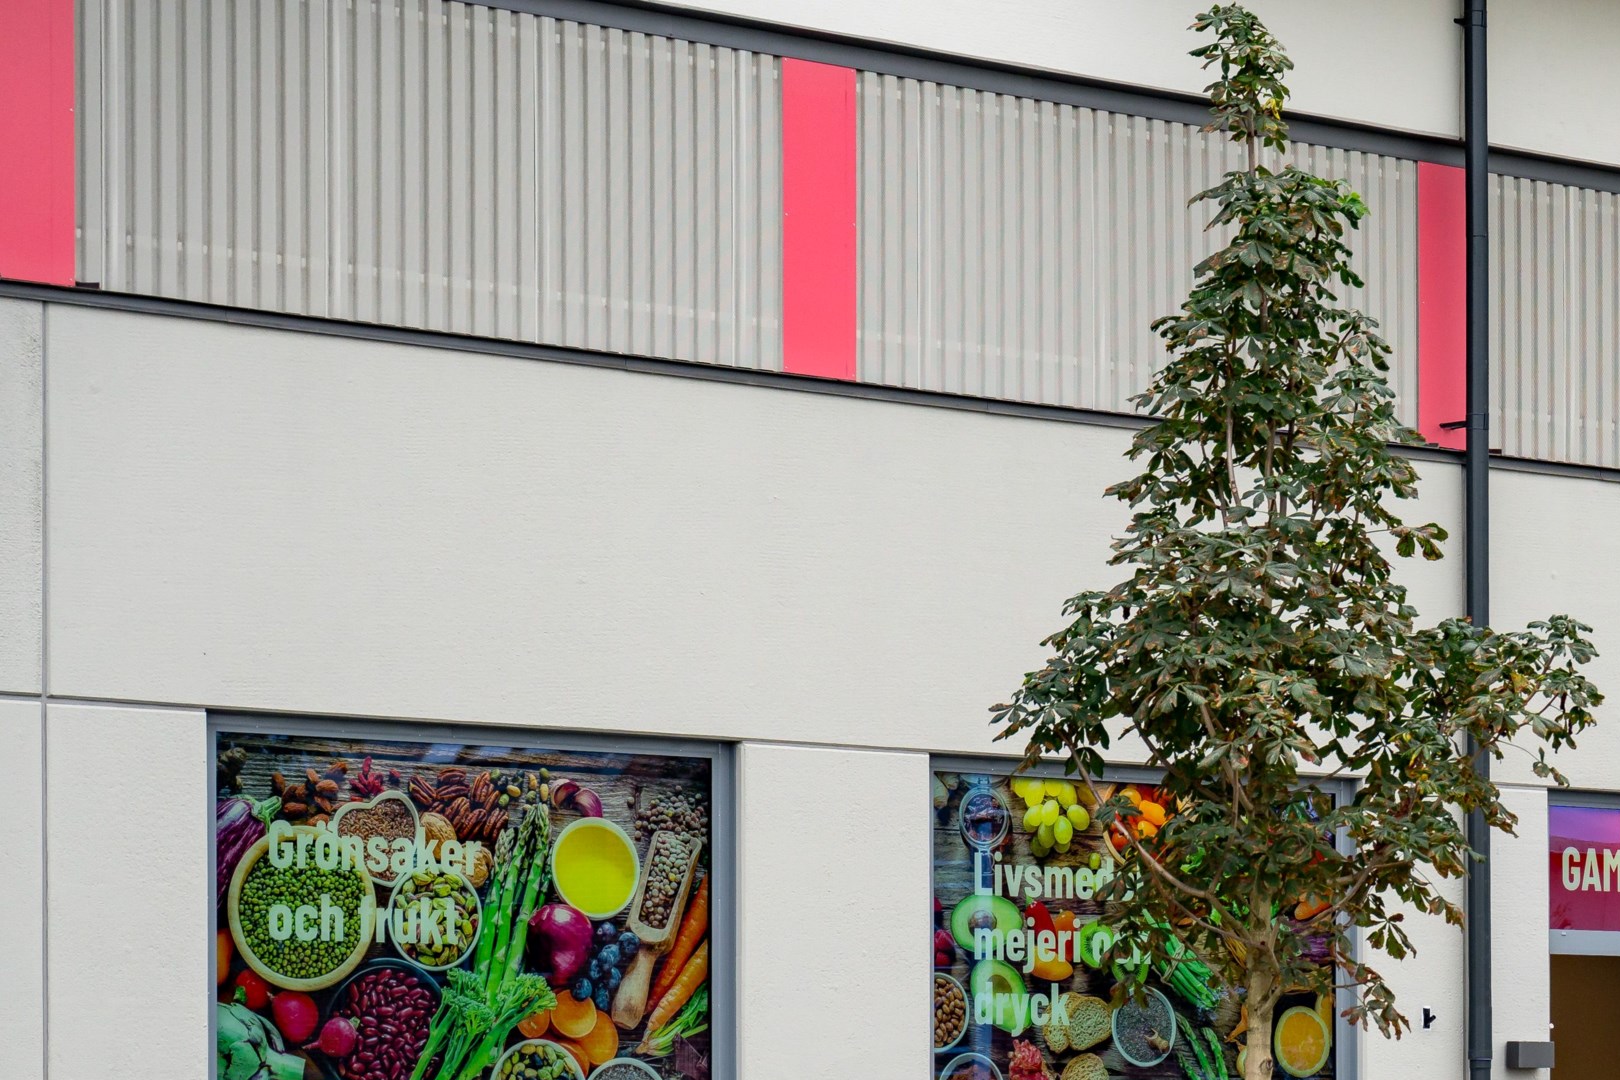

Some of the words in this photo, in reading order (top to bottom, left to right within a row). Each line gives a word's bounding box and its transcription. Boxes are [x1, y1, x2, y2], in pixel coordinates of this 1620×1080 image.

[269, 820, 483, 876] Grönsaker
[269, 893, 344, 942] och
[358, 894, 459, 945] frukt
[974, 916, 1081, 974] mejeri
[1092, 920, 1152, 966] oh
[974, 981, 1070, 1038] dryck
